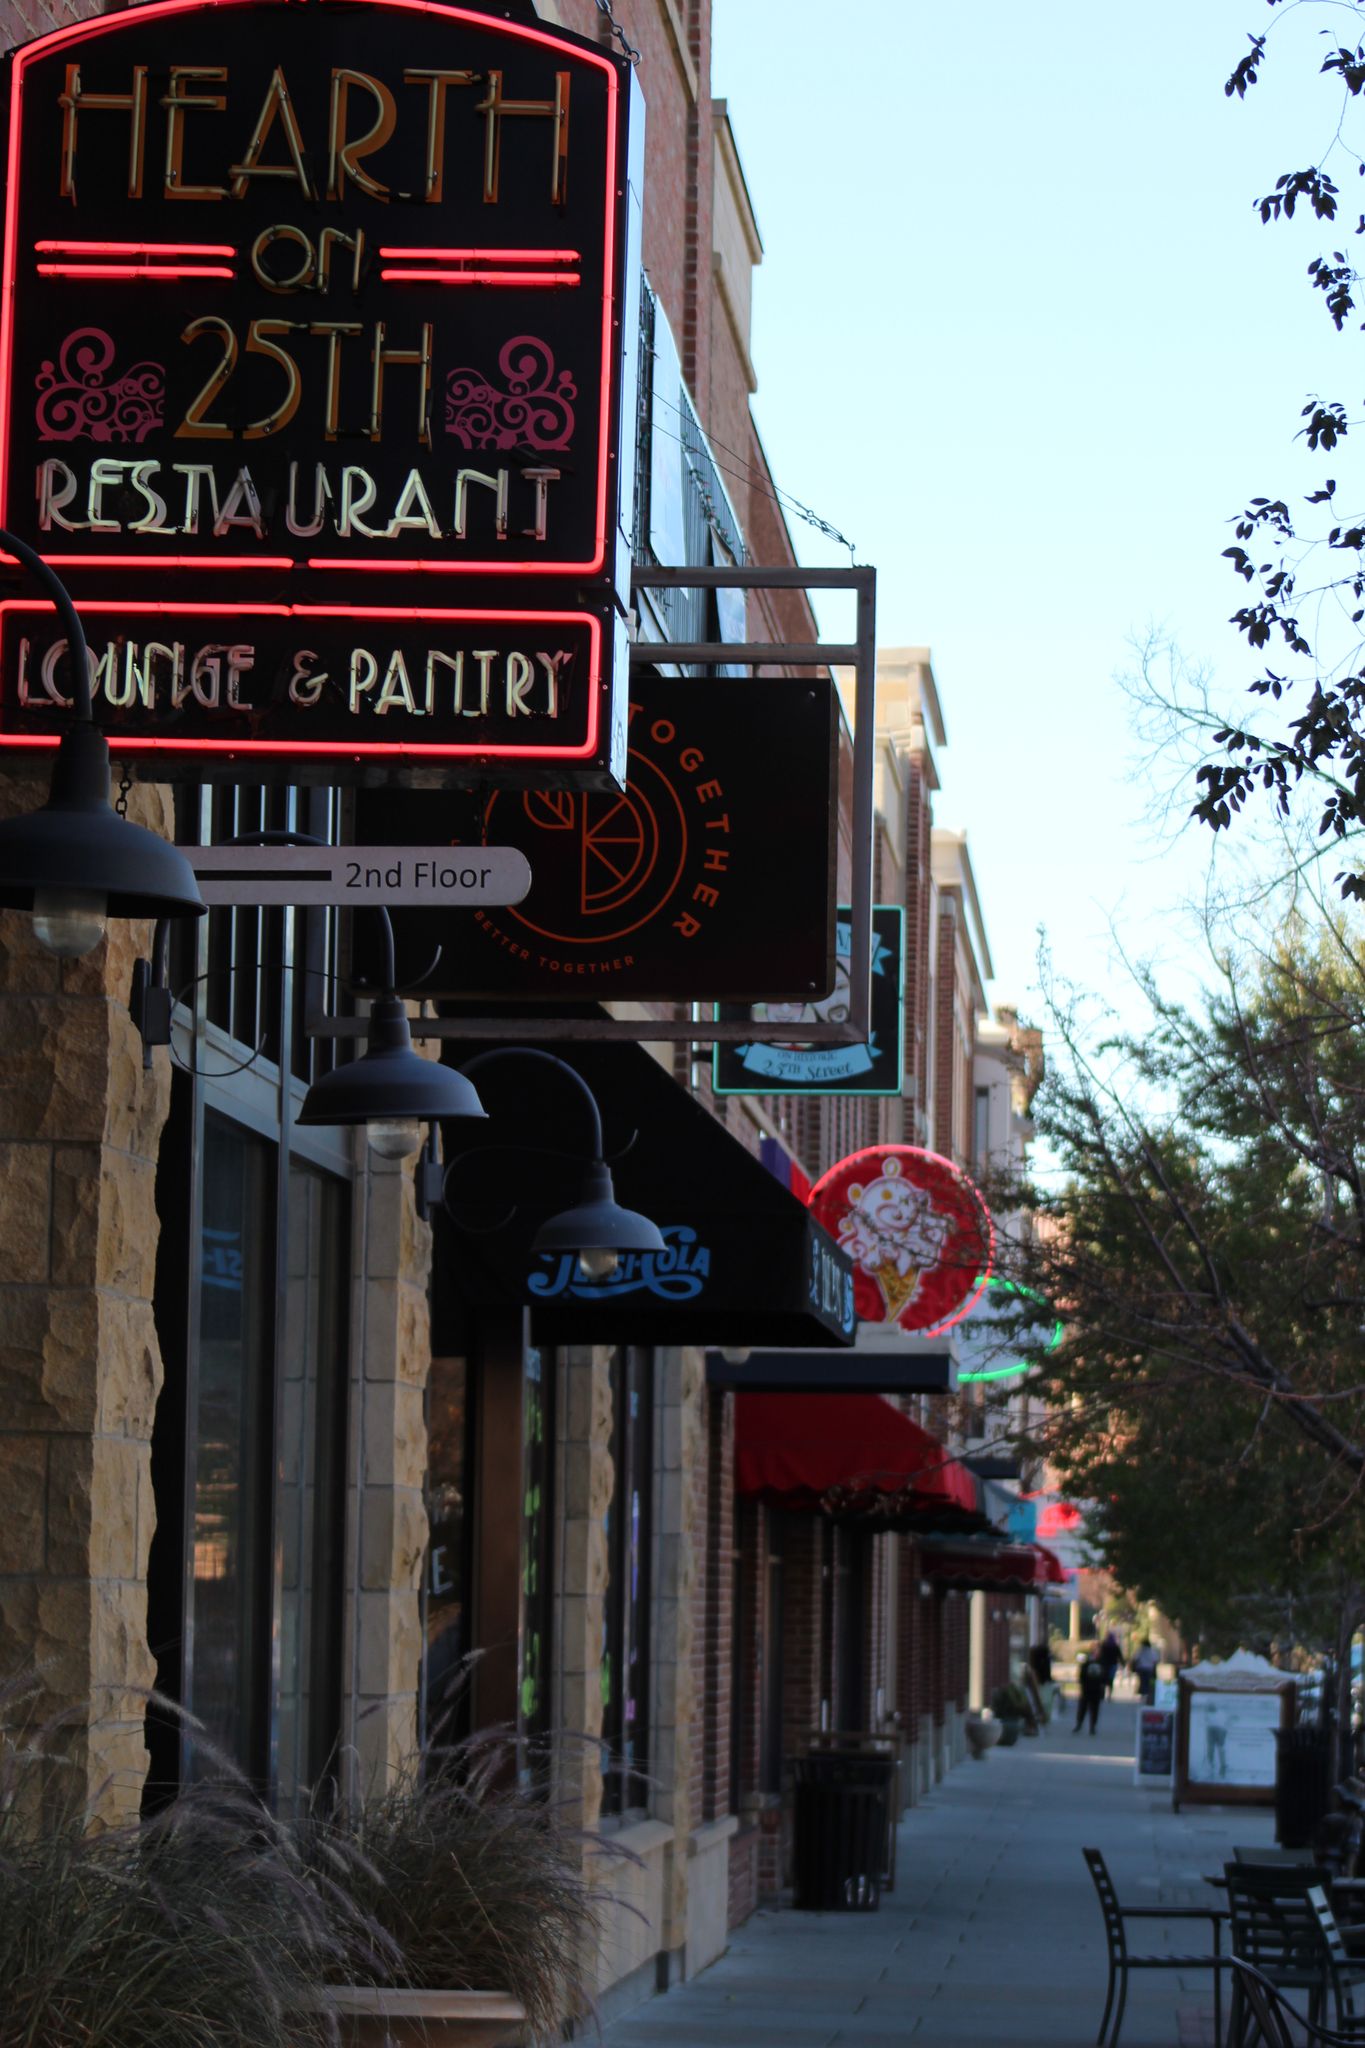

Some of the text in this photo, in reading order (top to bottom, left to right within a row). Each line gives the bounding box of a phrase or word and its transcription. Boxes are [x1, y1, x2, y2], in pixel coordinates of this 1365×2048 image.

[58, 63, 571, 206] HEARTH
[173, 316, 433, 449] 25TH
[36, 458, 561, 541] RESTAURANT
[18, 637, 573, 720] LOUNGE & PANTRY
[628, 702, 731, 938] TOGETHER
[345, 862, 492, 889] 2nd Floor
[474, 910, 635, 975] BETTER TOGETHER
